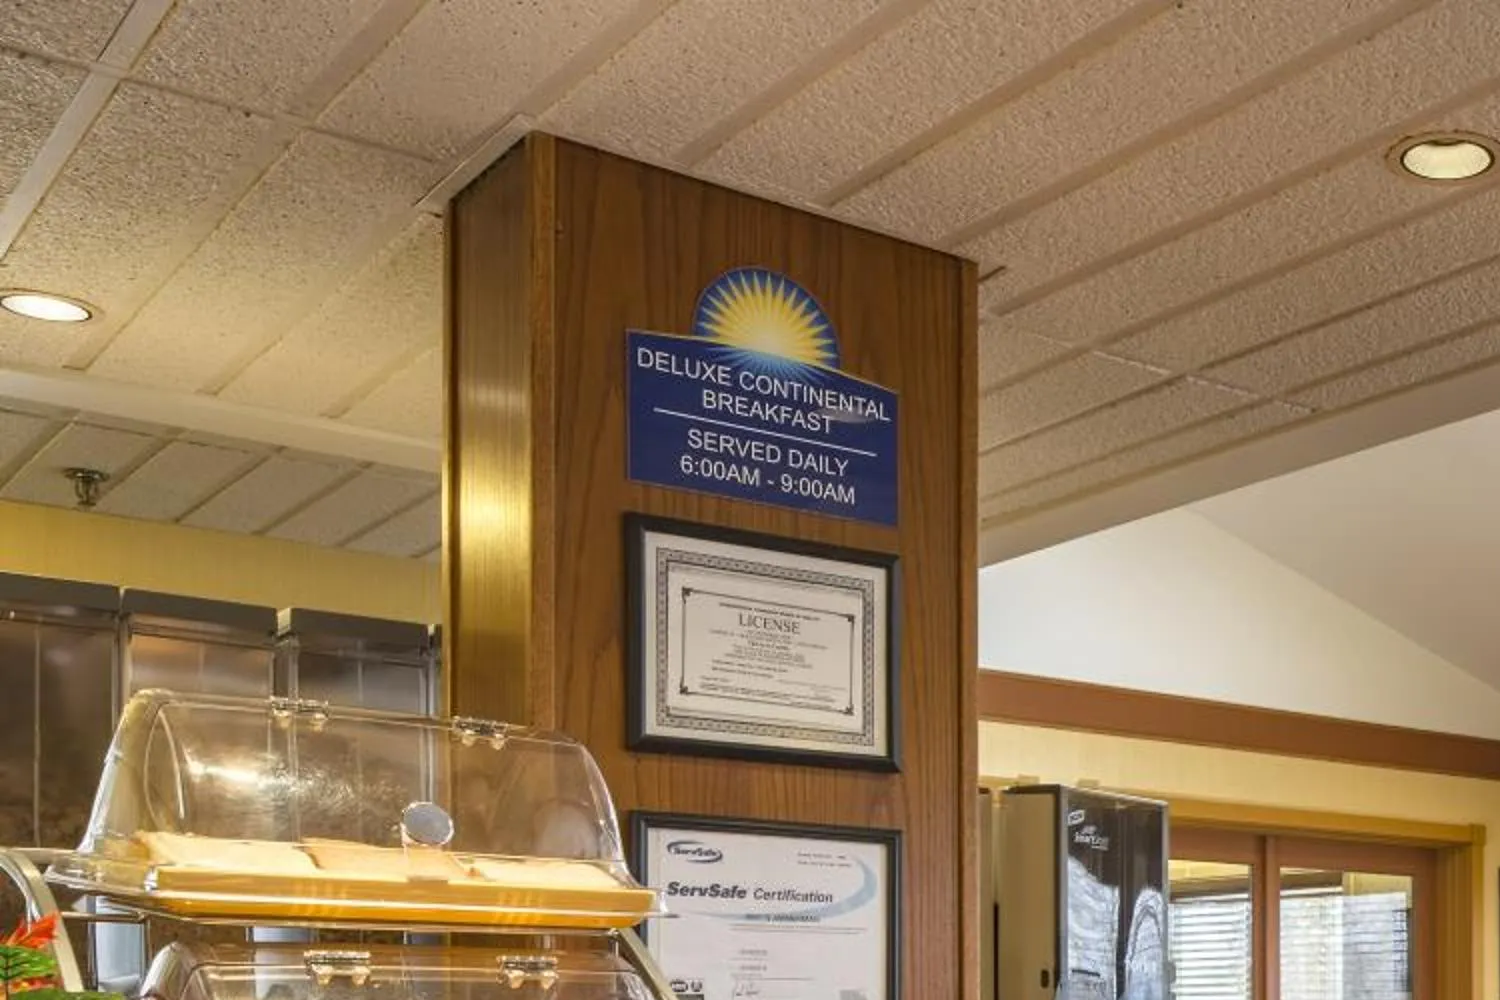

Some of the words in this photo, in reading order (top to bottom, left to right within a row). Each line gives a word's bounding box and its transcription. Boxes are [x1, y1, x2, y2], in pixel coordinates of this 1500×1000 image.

[636, 347, 732, 386] DELUXE
[739, 371, 892, 422] CONTINENTAL
[702, 391, 833, 434] BREAKFAST
[687, 428, 782, 464] SERVED
[788, 450, 850, 477] DAILY
[680, 455, 761, 488] 6:00AM
[781, 474, 856, 505] 9:00AM
[738, 612, 801, 635] LICENSE
[667, 881, 747, 900] ServSafe
[752, 886, 834, 904] Certification
